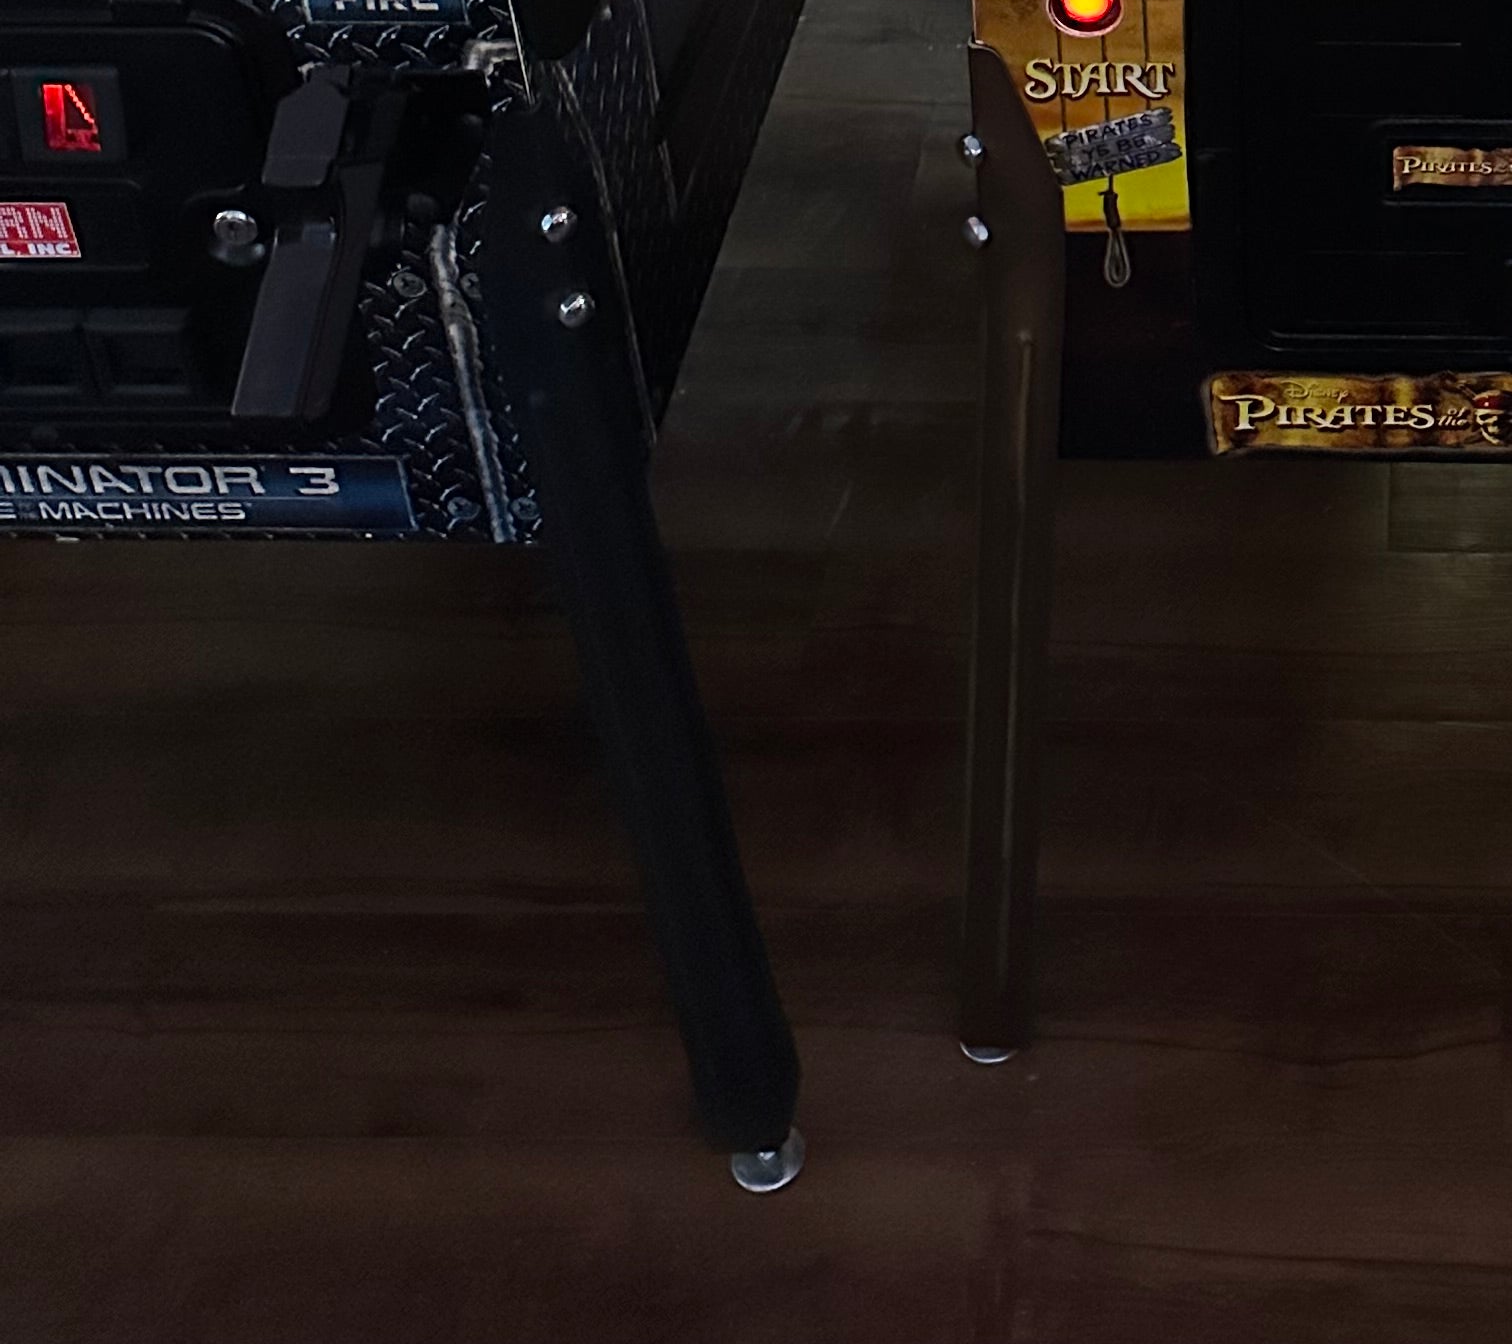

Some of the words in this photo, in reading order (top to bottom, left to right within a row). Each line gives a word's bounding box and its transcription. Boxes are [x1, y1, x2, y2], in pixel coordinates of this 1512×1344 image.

[1025, 59, 1174, 99] START
[1063, 113, 1153, 150] PIRATES
[1117, 135, 1146, 153] BE
[1071, 150, 1161, 181] WARNED
[1396, 156, 1493, 175] PIRATES
[1219, 395, 1435, 431] PIRATES
[289, 467, 341, 495] 3
[39, 501, 247, 521] MACHINES
